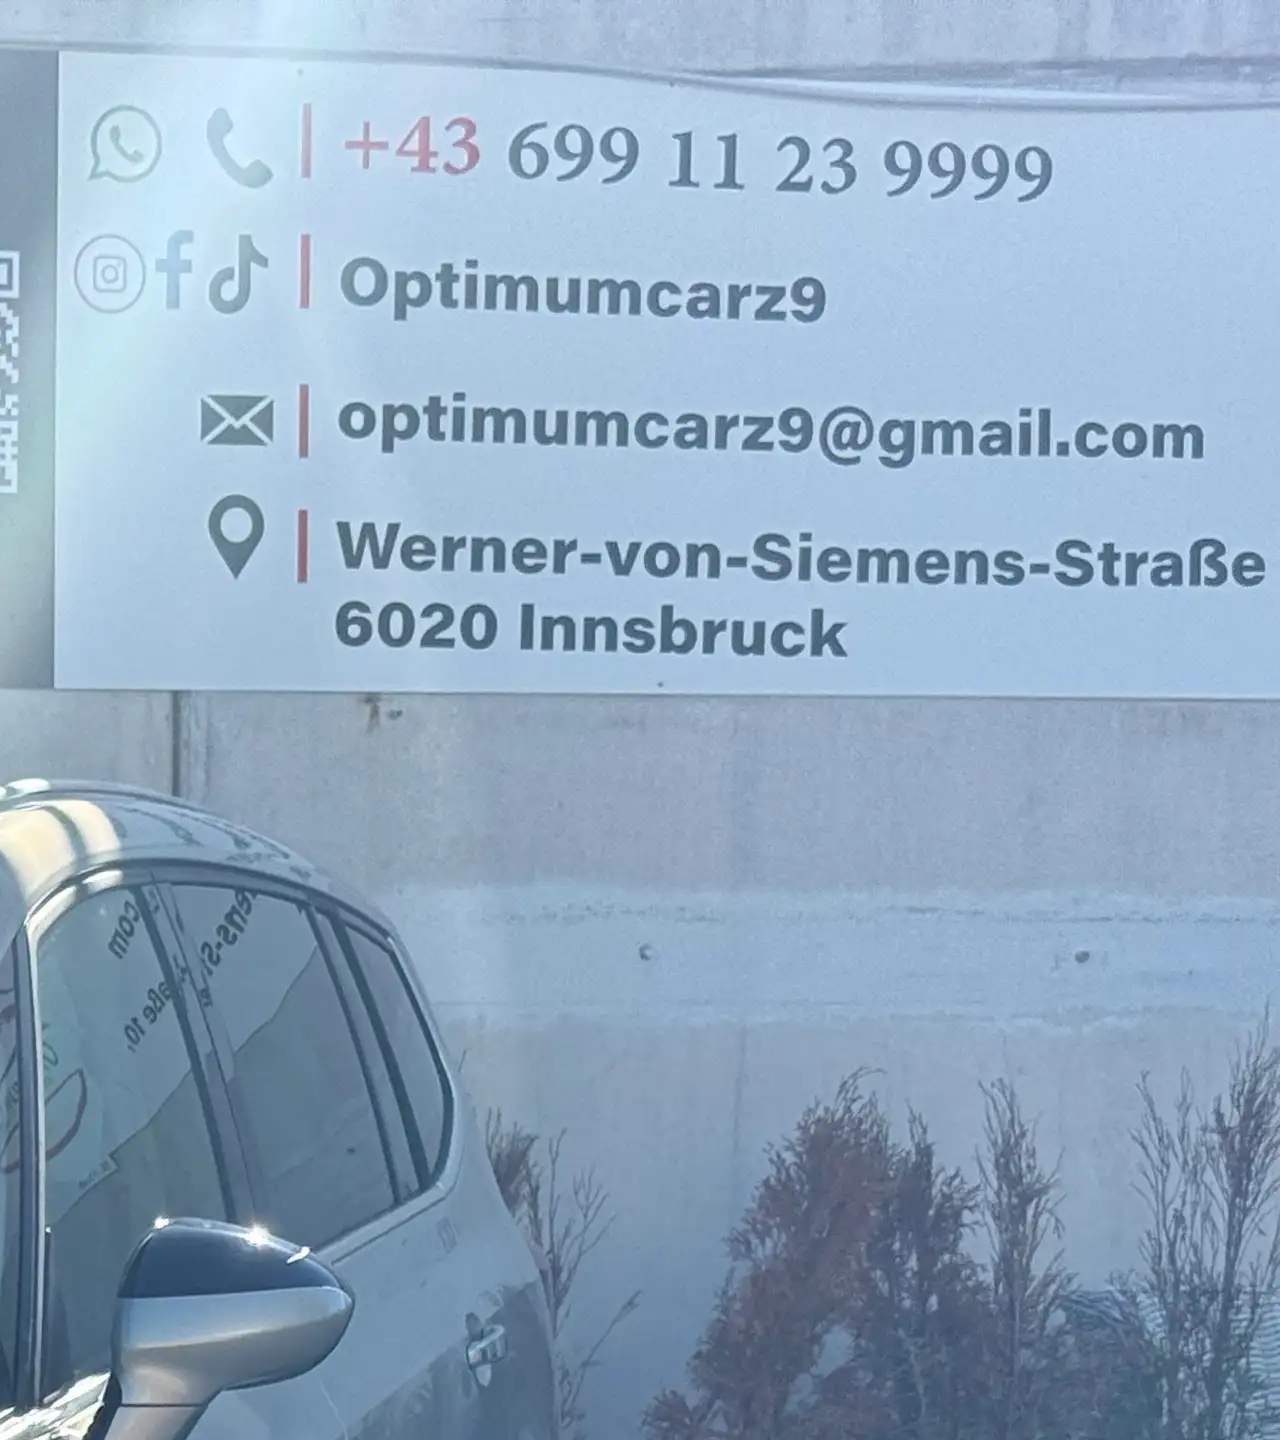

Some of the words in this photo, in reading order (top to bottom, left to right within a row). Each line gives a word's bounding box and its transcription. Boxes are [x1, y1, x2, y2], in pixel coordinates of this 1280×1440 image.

[343, 115, 481, 175] +43
[507, 121, 640, 184] 699
[668, 130, 745, 191] 11
[775, 135, 858, 195] 23
[882, 139, 1054, 202] 9999
[339, 256, 827, 322] Optimumcarz9
[336, 392, 1205, 469] optimumcarz9@gmail.com
[336, 519, 1267, 589] Werner-von-Siemens-Straße
[334, 601, 498, 650] 6020
[517, 602, 850, 659] Innsbruck
